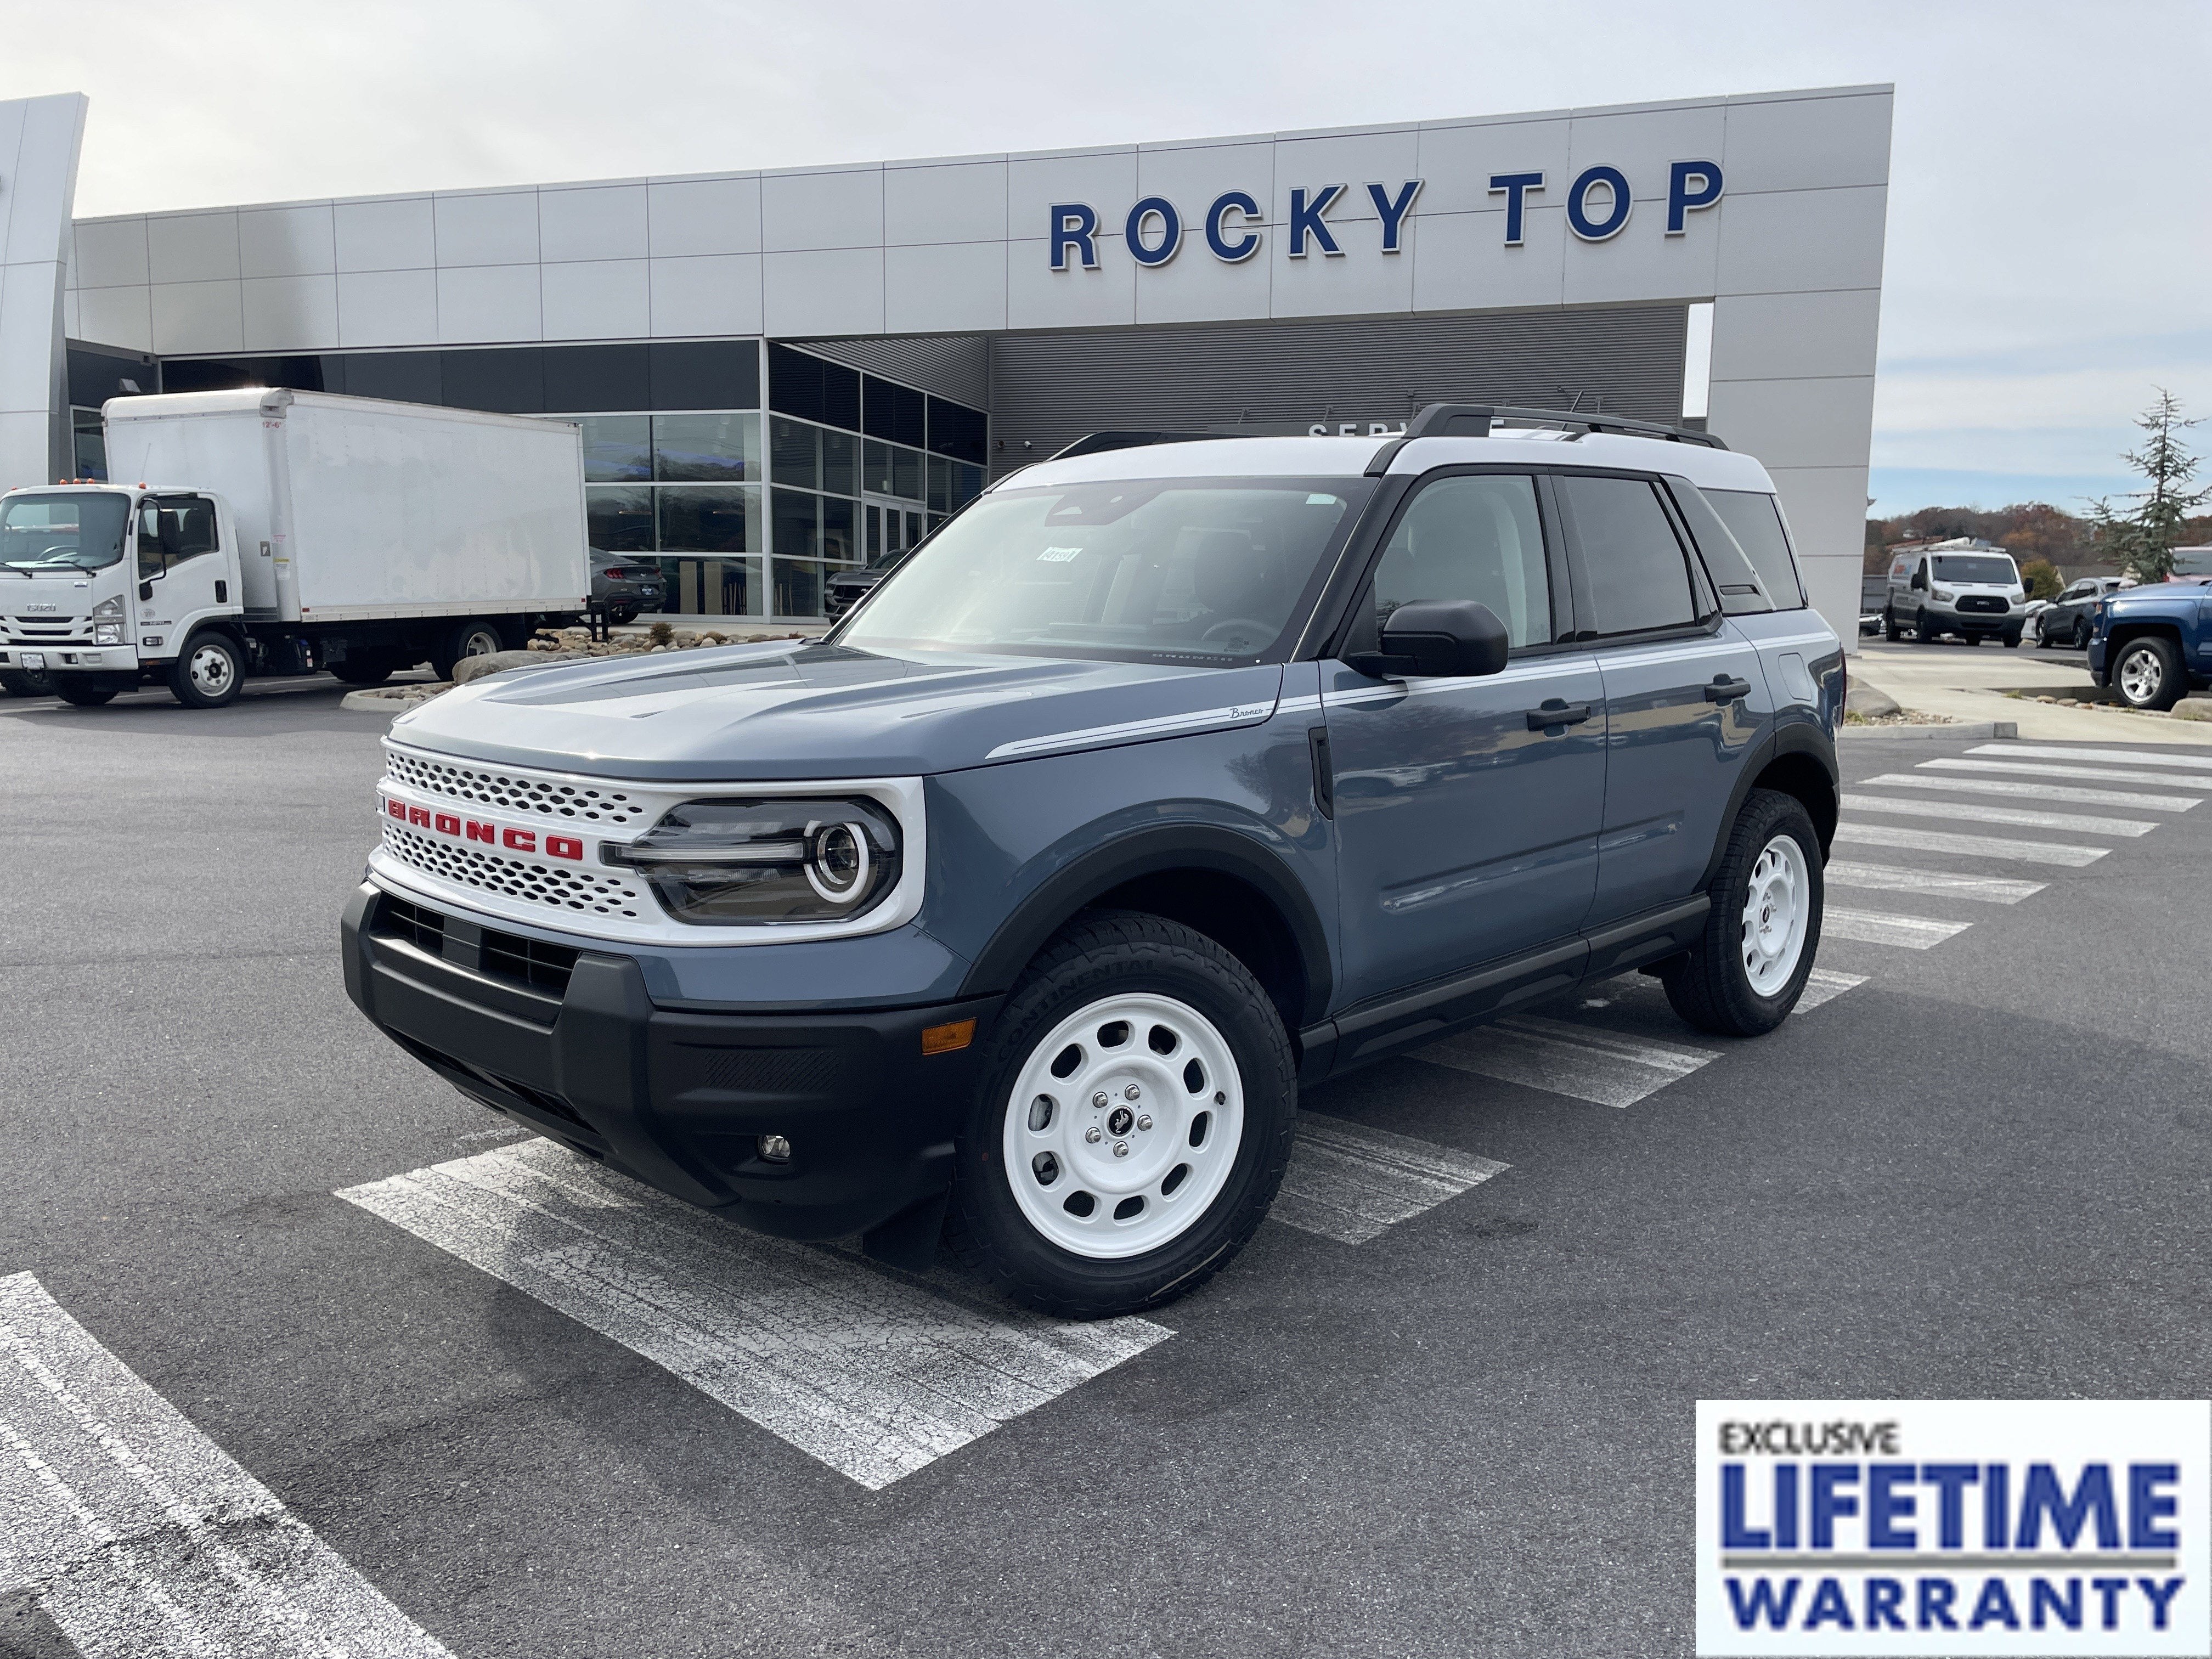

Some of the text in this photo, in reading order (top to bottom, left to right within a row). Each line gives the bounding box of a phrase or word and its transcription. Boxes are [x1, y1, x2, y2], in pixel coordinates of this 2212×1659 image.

[1048, 159, 1724, 270] ROCKY TOP
[1229, 708, 1263, 718] Bronco
[388, 797, 583, 860] BRONCO
[996, 959, 1157, 1064] CONTINENTAL
